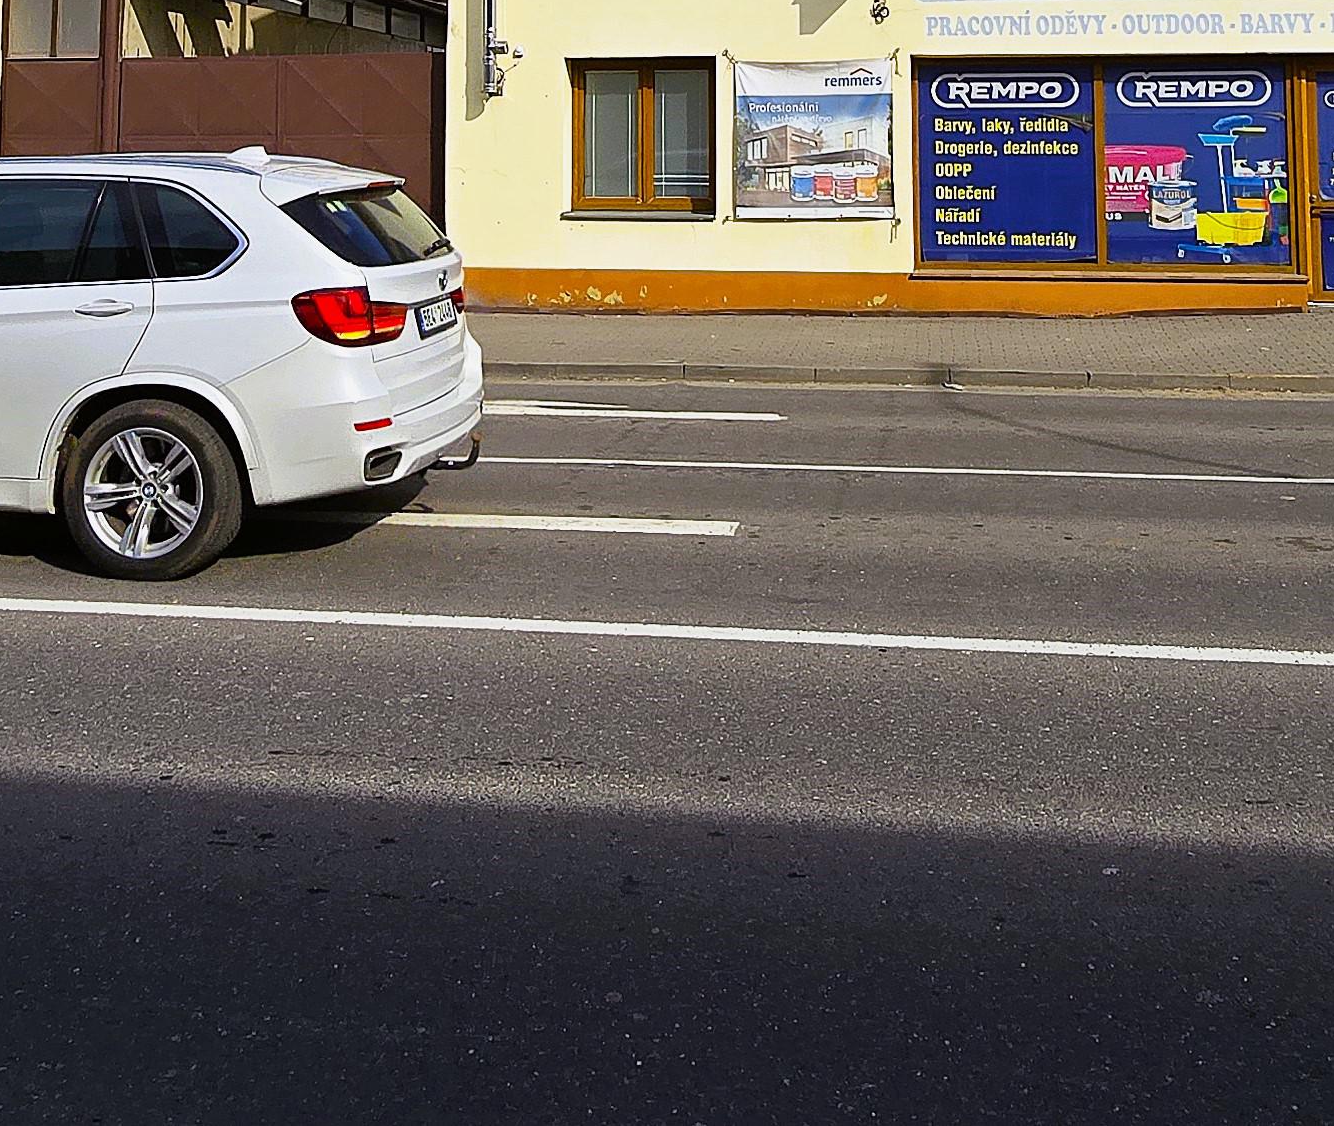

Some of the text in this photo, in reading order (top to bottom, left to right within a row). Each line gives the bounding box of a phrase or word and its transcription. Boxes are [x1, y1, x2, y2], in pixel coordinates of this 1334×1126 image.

[926, 10, 1031, 36] PRACOVNÍ
[1035, 10, 1107, 35] ODĚVY
[1122, 13, 1224, 35] OUTDOOR
[1239, 12, 1315, 34] BARVY
[824, 74, 883, 88] remmers
[748, 101, 819, 114] Profesionální
[934, 117, 1068, 135] Barvy, laky, ředidla
[935, 140, 1079, 157] Drogerie, dezinfekce
[935, 163, 972, 177] OOPP
[935, 185, 997, 200] Oblečení
[935, 207, 981, 222] Nářadí
[935, 230, 1077, 250] Technické materiály
